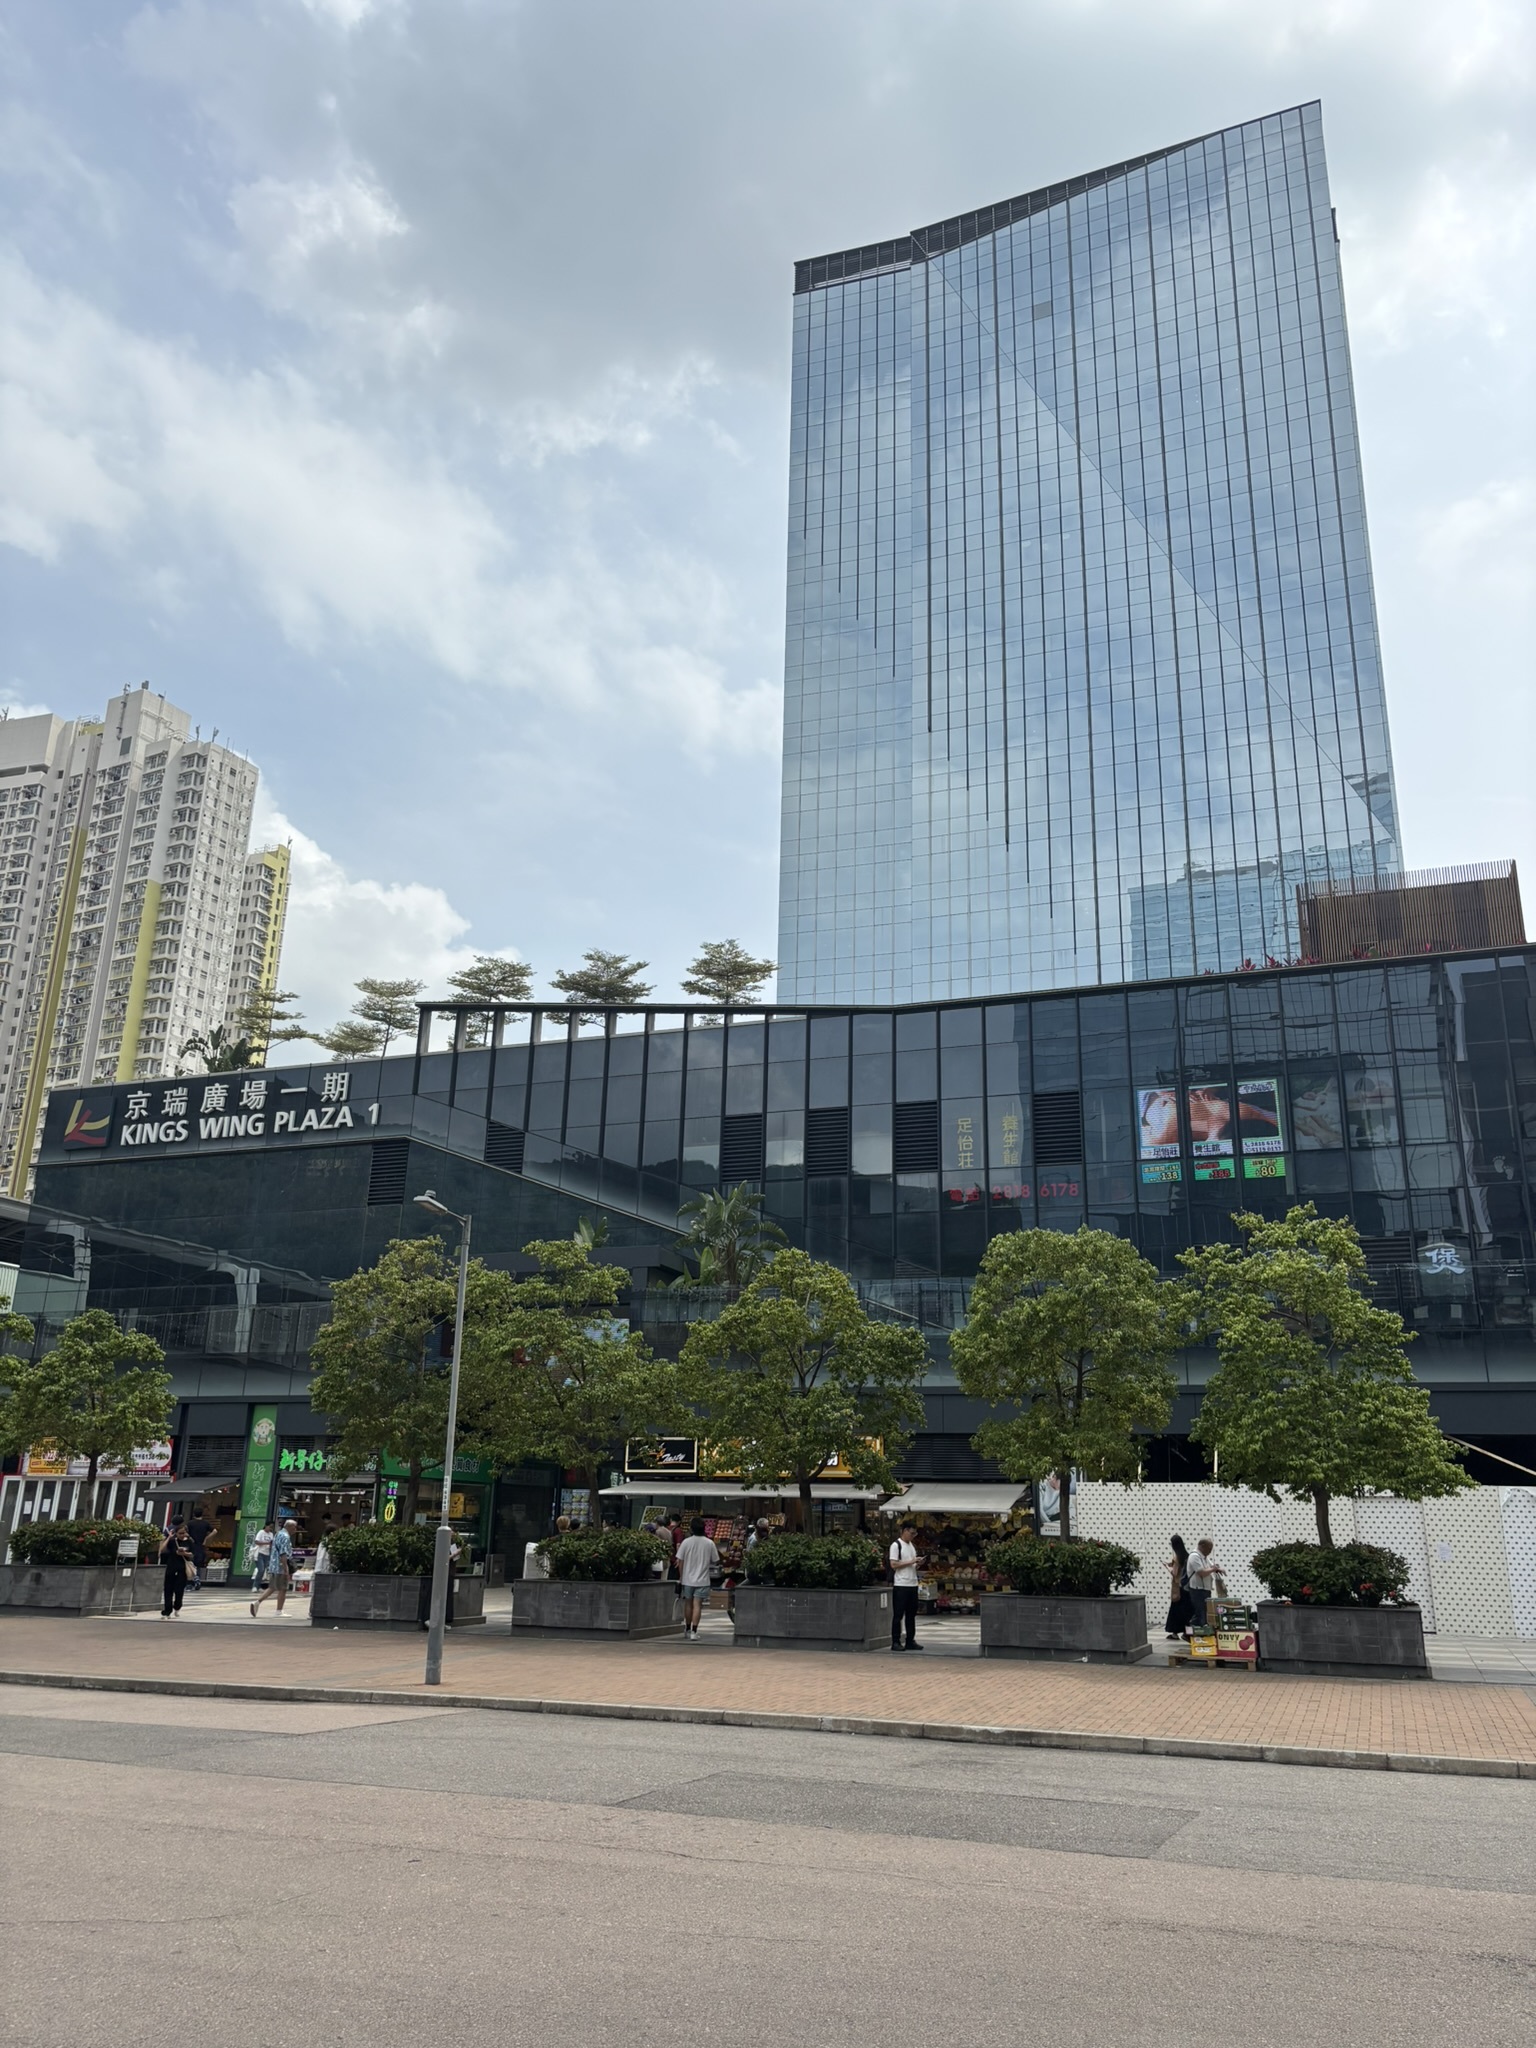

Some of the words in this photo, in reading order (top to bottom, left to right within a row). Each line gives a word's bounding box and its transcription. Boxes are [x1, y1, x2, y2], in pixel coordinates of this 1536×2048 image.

[124, 1072, 350, 1121] 京瑞廣場一期
[120, 1120, 189, 1146] KINGS
[199, 1113, 266, 1140] WING
[273, 1105, 354, 1134] PLAZA
[368, 1103, 380, 1125] 1
[992, 1184, 1030, 1200] 2818
[1040, 1183, 1079, 1197] 6178
[1425, 1247, 1466, 1275] 煲
[661, 1452, 686, 1463] Tasty
